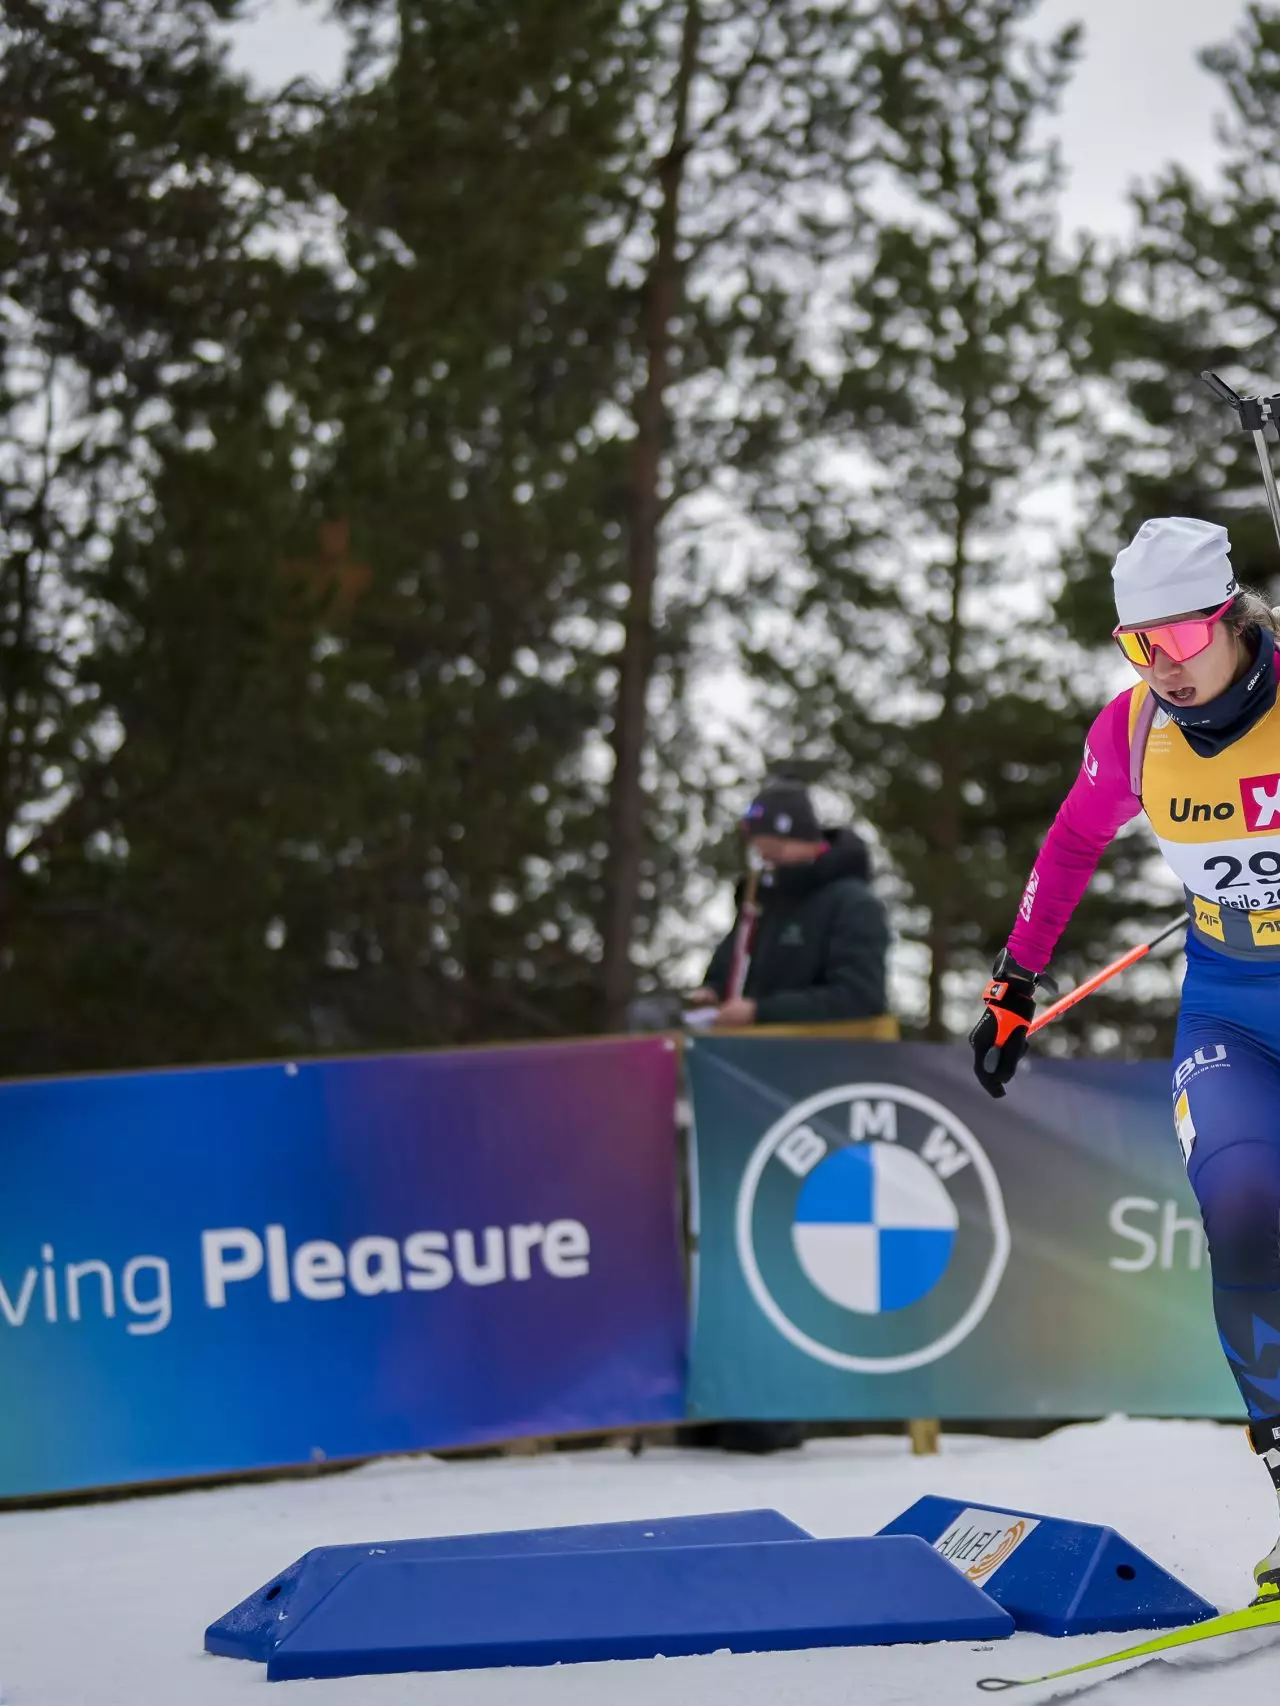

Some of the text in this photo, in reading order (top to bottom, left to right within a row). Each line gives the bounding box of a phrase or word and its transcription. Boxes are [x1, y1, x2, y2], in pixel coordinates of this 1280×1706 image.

[1169, 797, 1235, 823] Uno
[1218, 896, 1261, 909] Geilo
[1199, 911, 1219, 927] AF
[777, 1101, 970, 1178] BMW
[201, 1218, 592, 1309] Pleasure
[936, 1525, 1003, 1562] AMFI
